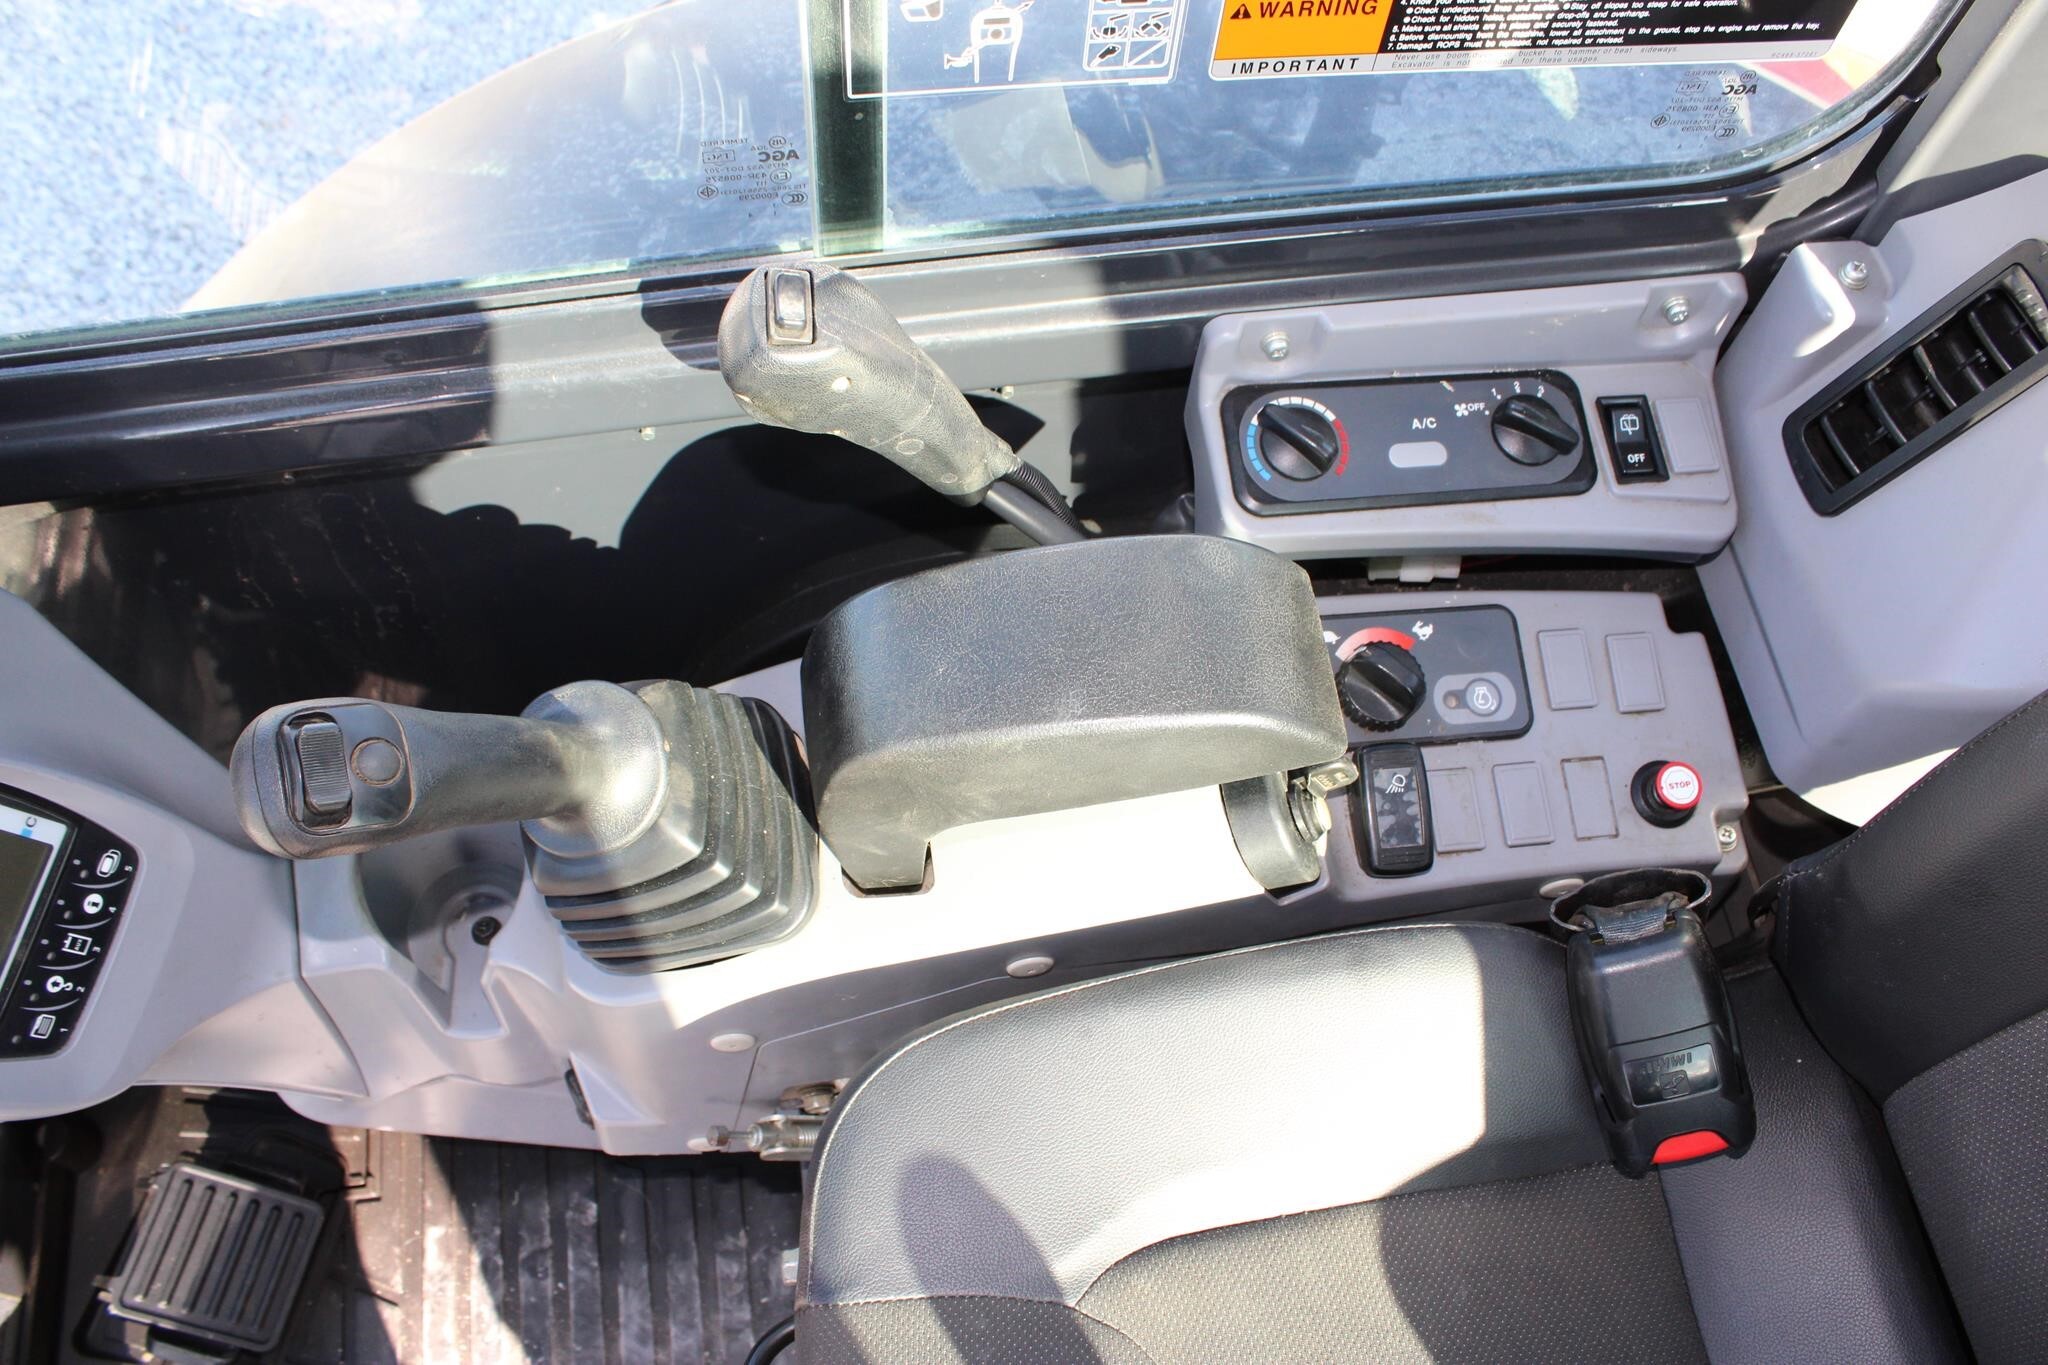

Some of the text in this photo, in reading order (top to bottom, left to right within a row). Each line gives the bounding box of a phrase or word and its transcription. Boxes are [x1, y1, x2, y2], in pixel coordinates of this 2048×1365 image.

[1260, 0, 1378, 18] WARNING
[1442, 5, 1491, 14] underground
[1604, 2, 1628, 10] slopes
[1647, 1, 1668, 9] steep
[1453, 14, 1480, 22] hidden
[1557, 10, 1590, 20] drop-offs
[1611, 10, 1650, 19] overhangs.
[1402, 24, 1423, 32] Make
[1452, 24, 1480, 32] shields
[1552, 20, 1582, 29] securely
[1586, 20, 1618, 28] fastened.
[1427, 32, 1473, 41] dismounting
[1549, 29, 1570, 37] lower
[1584, 28, 1626, 36] attachment
[1684, 26, 1700, 34] stop
[1718, 25, 1743, 34] engine
[1806, 22, 1820, 30] key.
[1396, 42, 1433, 50] Damaged
[1552, 38, 1582, 46] repaired
[1232, 58, 1360, 74] IMPORTANT
[1467, 402, 1486, 412] OFF
[1412, 417, 1438, 430] A/C
[1627, 453, 1646, 464] OFF
[1668, 780, 1691, 790] STOP
